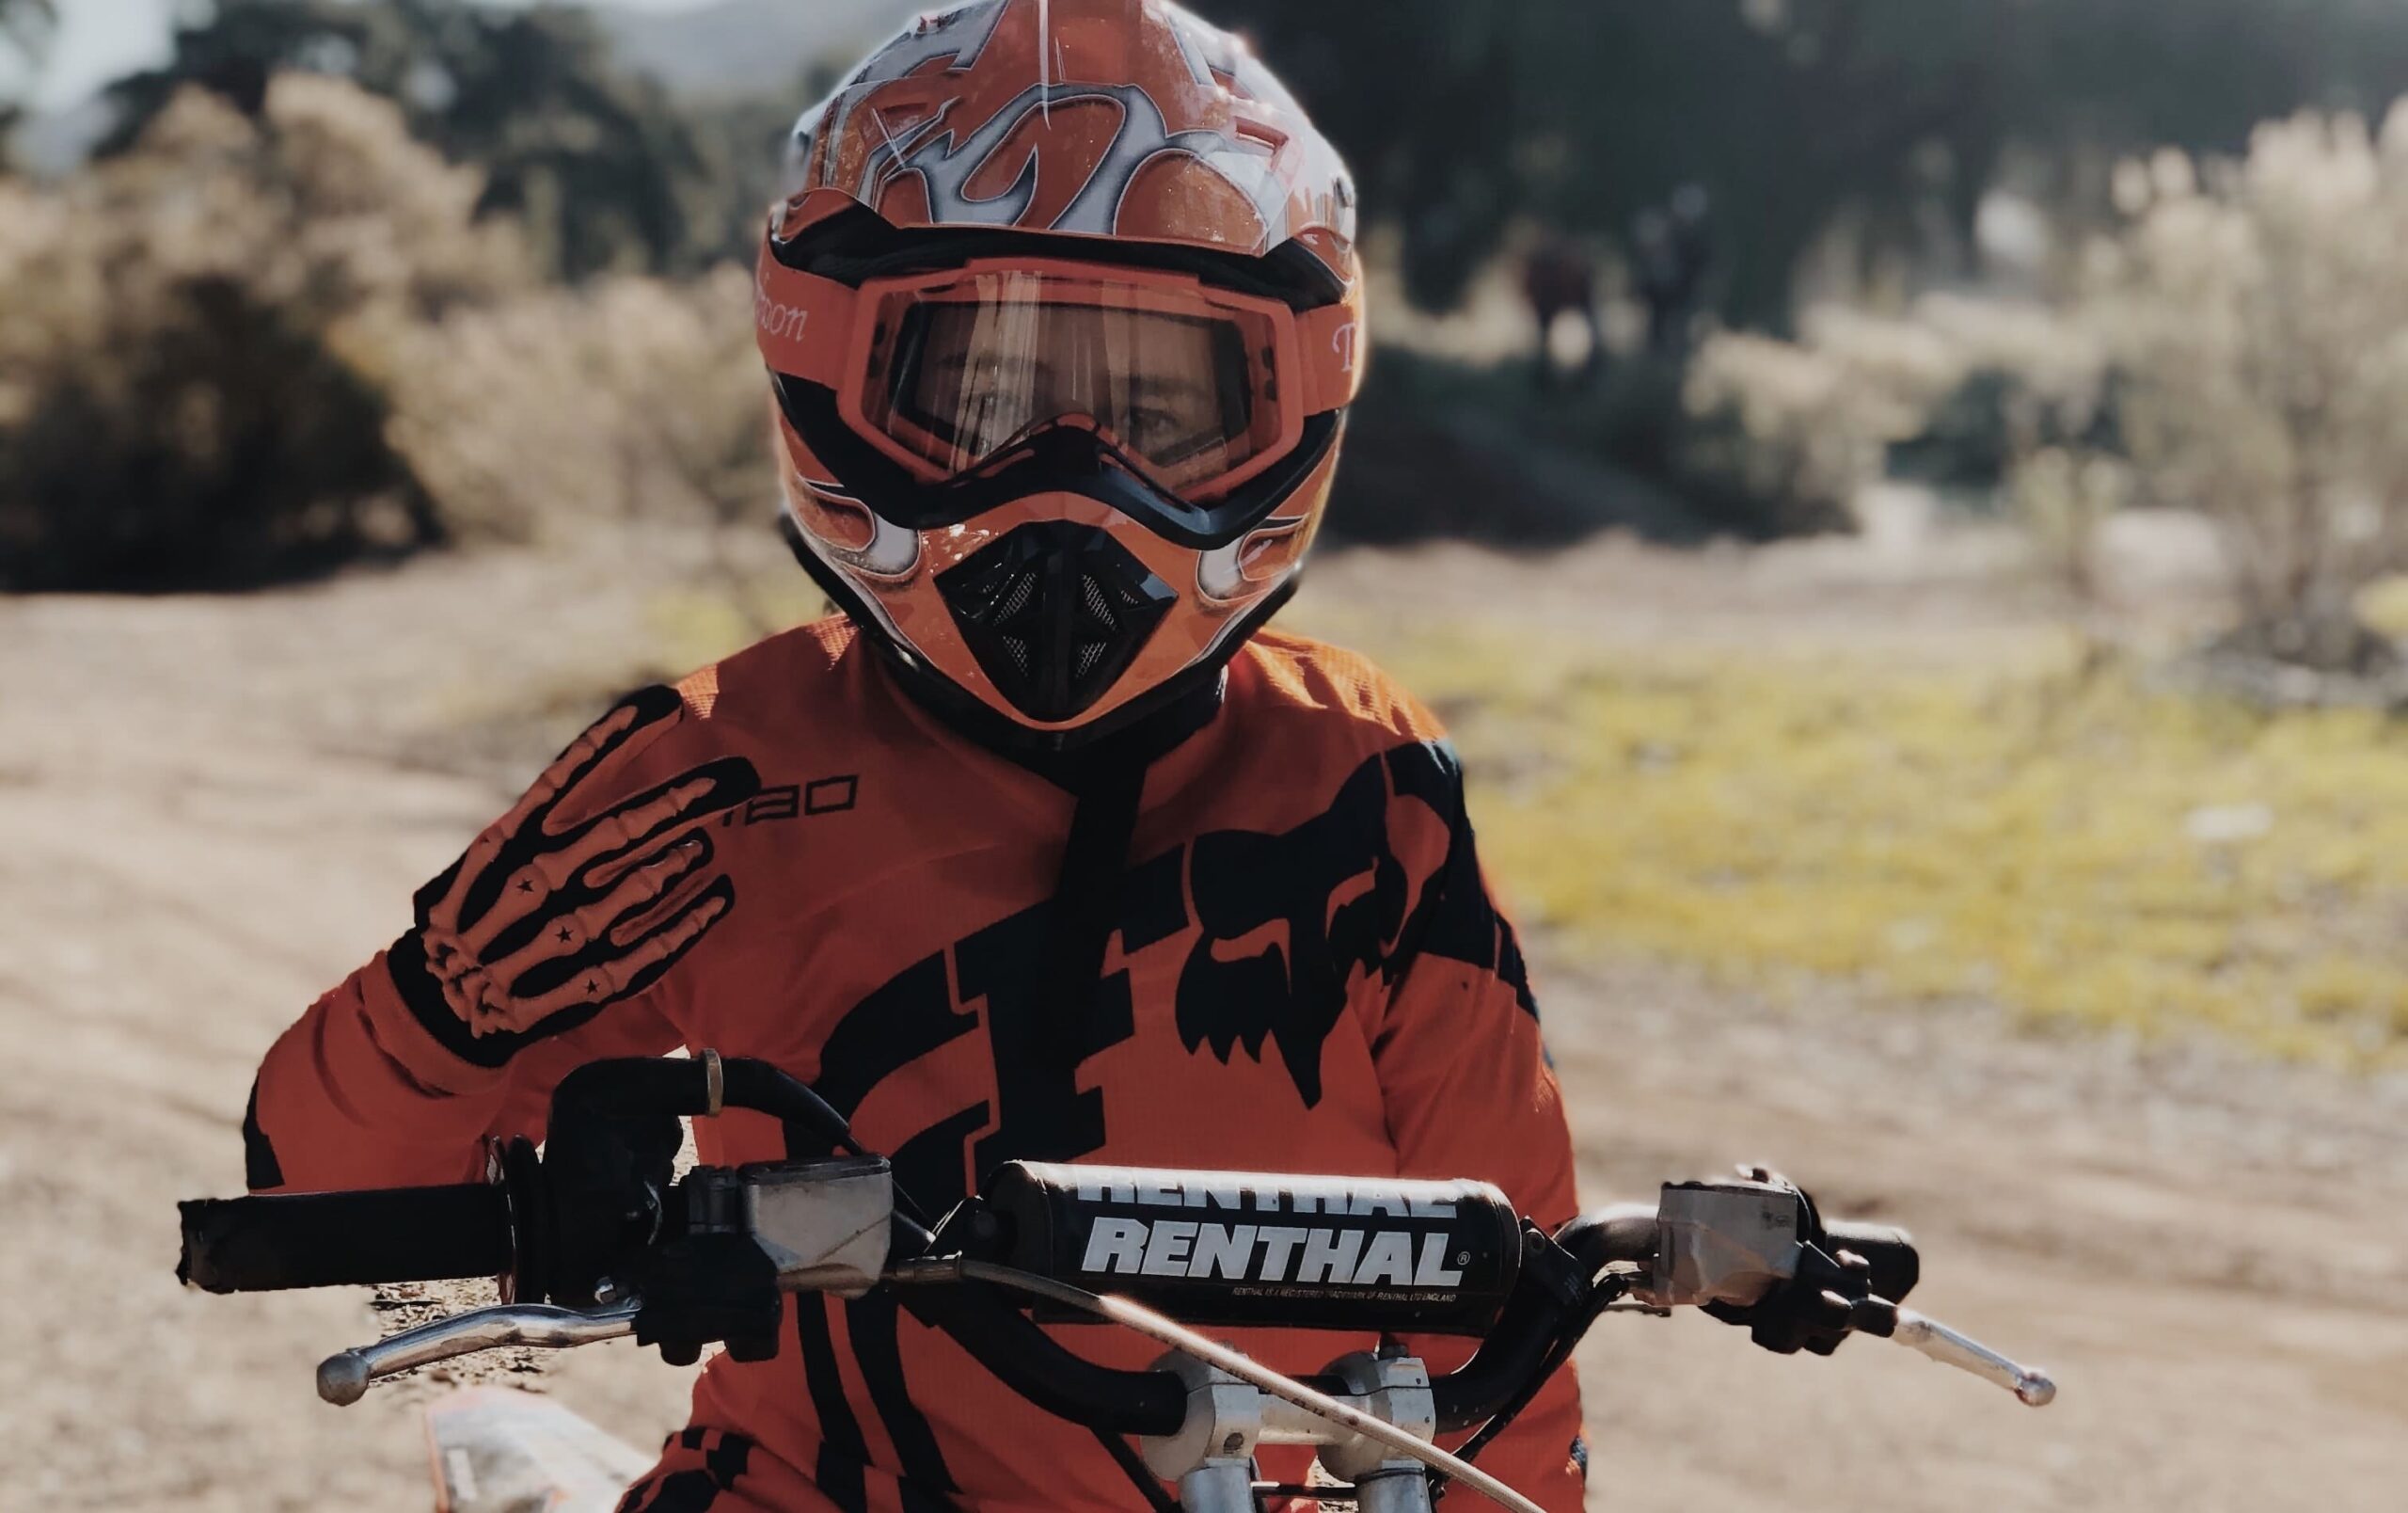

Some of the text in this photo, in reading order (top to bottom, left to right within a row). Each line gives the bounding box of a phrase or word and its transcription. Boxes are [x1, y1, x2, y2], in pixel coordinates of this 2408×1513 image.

[1081, 1216, 1463, 1287] RENTHAL
[1232, 1286, 1262, 1297] RENTHAL
[1377, 1291, 1408, 1301] RENTHAL
